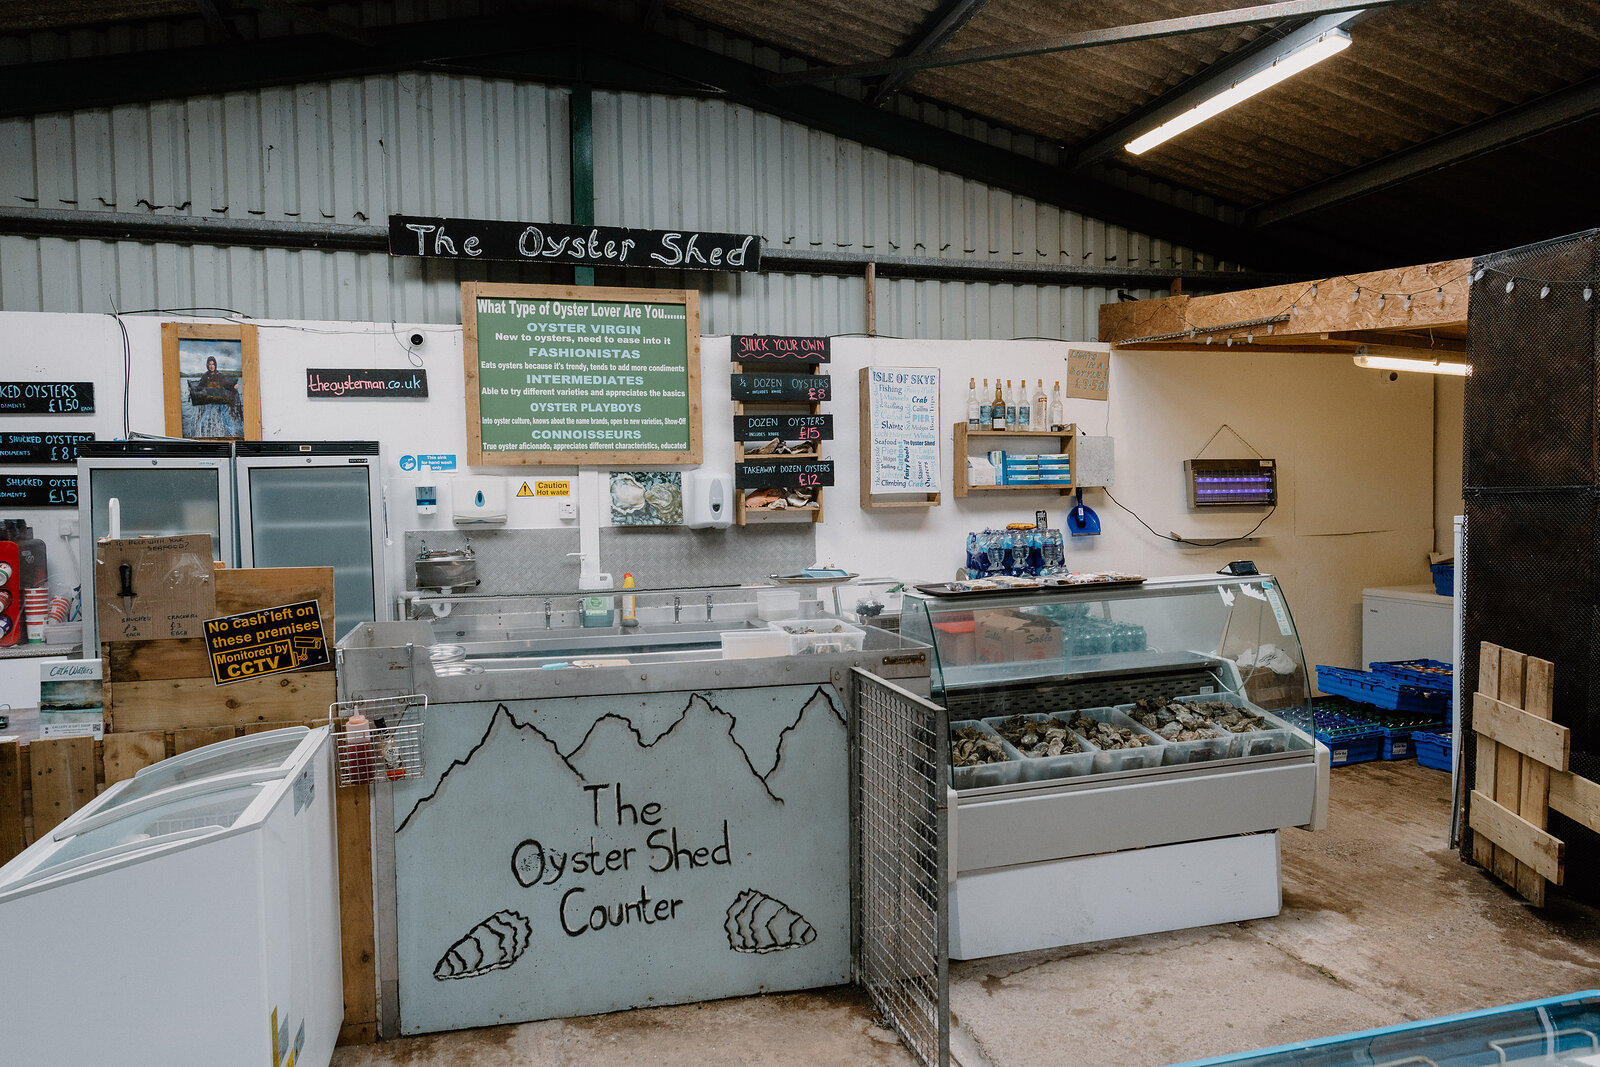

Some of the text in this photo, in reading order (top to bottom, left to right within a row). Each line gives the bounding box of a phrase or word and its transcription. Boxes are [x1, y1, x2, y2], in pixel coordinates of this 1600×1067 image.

[406, 224, 754, 266] The Oyster Shed
[477, 299, 506, 314] What
[509, 300, 536, 318] Type
[539, 301, 550, 315] of
[553, 302, 588, 319] Oyster
[591, 303, 621, 317] Lover
[623, 304, 642, 318] Are
[527, 322, 640, 334] OYSTER VIRGIN
[534, 334, 574, 343] oysters,
[740, 336, 824, 352] SHUCK YOUR OWN
[528, 347, 640, 359] FASHIONISTAS
[481, 361, 496, 369] Eats
[498, 362, 522, 371] oysters
[524, 362, 552, 370] because
[554, 362, 564, 370] it's
[566, 362, 588, 372] trendy,
[648, 364, 685, 372] condiments
[526, 374, 644, 385] INTERMEDIATES
[754, 378, 829, 390] DOZEN OYSTERS
[873, 372, 936, 384] ISLE OF SKYE
[25, 384, 76, 398] OYSTERS
[308, 374, 421, 396] theoysterman.co.uk
[879, 384, 902, 395] Fishing
[481, 387, 499, 395] Able
[510, 388, 521, 397] try
[523, 388, 555, 396] different
[606, 389, 648, 398] appreciates
[808, 388, 826, 400] £8
[48, 399, 78, 412] £1.50
[530, 402, 642, 412] OYSTER PLAYBOYS
[494, 418, 510, 426] oyster
[512, 417, 532, 426] culture,
[590, 418, 610, 426] brands,
[641, 418, 664, 426] varieties,
[748, 416, 824, 428] DOZEN OYSTERS
[912, 414, 930, 422] PIER
[9, 435, 41, 444] SHUCKED
[532, 430, 642, 440] CONNOISSEURS
[798, 427, 820, 440] £15
[498, 443, 518, 451] oyster
[519, 442, 552, 450] aficionado,
[553, 442, 588, 451] appreciates
[615, 442, 660, 450] characteristics,
[743, 464, 830, 474] TAKEAWAY DOZEN OYSTERS
[6, 478, 42, 486] SHUCKED
[798, 473, 820, 486] £12
[881, 480, 906, 488] Climbing
[208, 606, 314, 633] No cash left on
[212, 620, 320, 648] these premises
[217, 644, 288, 664] Monitored by
[227, 656, 280, 677] CCTV
[584, 783, 662, 826] The
[511, 820, 732, 888] Oyster Shed
[560, 886, 683, 937] Counter
